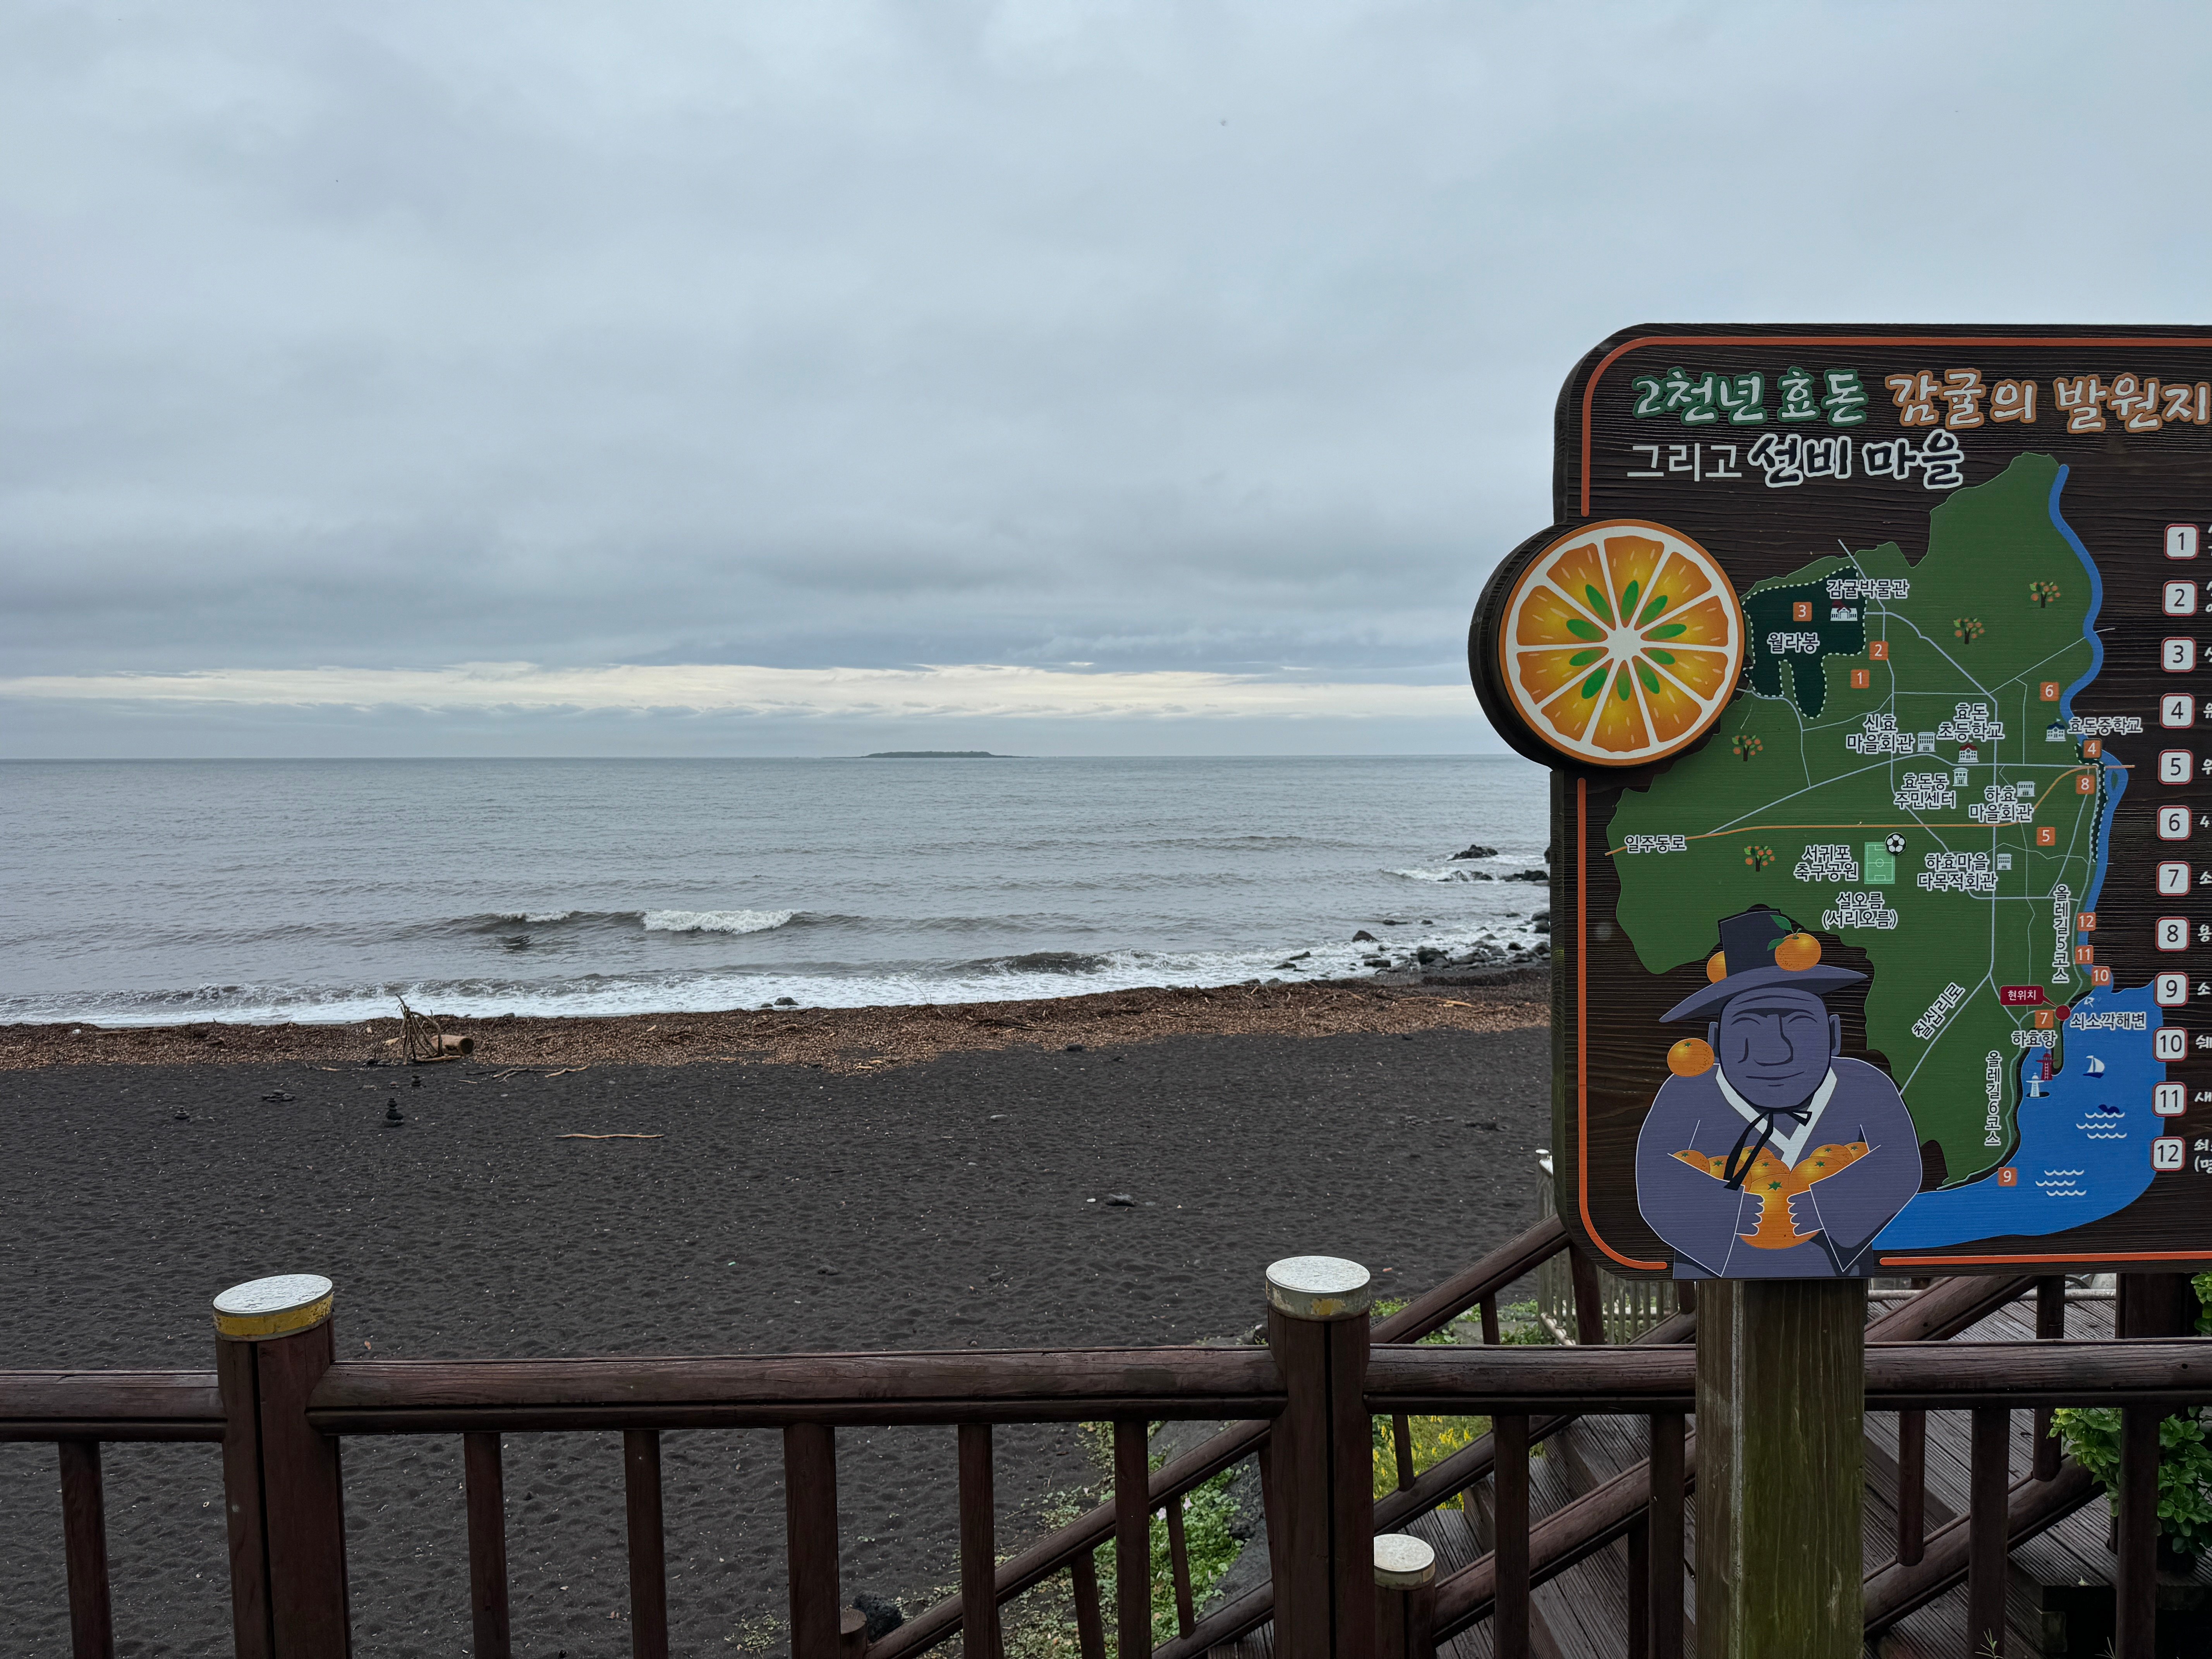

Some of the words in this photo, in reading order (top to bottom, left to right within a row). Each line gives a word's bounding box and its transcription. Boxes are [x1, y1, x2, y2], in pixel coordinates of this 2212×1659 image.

[1632, 366, 1767, 426] 2천년
[1778, 366, 1869, 426] 효돈
[1886, 368, 2037, 429] 감귤의
[2053, 373, 2210, 434] 발원지
[1627, 443, 1741, 482] 그리고
[1862, 429, 1964, 489] 마을
[2178, 532, 2184, 550] 1
[1826, 579, 1910, 599] 감귤박물관
[2174, 589, 2185, 607] 2
[1798, 605, 1806, 618] 3
[1767, 632, 1820, 654] 월라봉
[1874, 644, 1882, 657] 2
[2172, 645, 2183, 663] 3
[1857, 672, 1863, 684] 1
[2045, 685, 2053, 697] 6
[1953, 702, 1989, 722] 효돈
[2171, 701, 2183, 720] 4
[1863, 714, 1898, 733] 신효
[1937, 721, 2005, 742] 초등학교
[2067, 717, 2143, 737] 효돈중학교
[1846, 733, 1915, 754] 마을회관
[2088, 743, 2096, 754] 4
[2171, 758, 2181, 776] 5
[1901, 773, 1949, 791] 효돈동
[2081, 778, 2089, 790] 8
[1893, 790, 1956, 809] 주민센터
[1984, 785, 2017, 804] 하효
[1968, 803, 2034, 824] 마을회관
[2169, 813, 2180, 831] 6
[1624, 835, 1687, 853] 일주동로
[2042, 830, 2050, 842] 5
[1802, 844, 1852, 863] 서귀포
[1925, 852, 1990, 872] 하효마을
[1793, 862, 1859, 882] 축구공원
[2168, 869, 2179, 887] 7
[1917, 871, 1998, 892] 다목적회관
[1836, 891, 1885, 910] 설오름
[1821, 909, 1898, 930] (서리오름)
[2079, 917, 2094, 928] 12
[2167, 924, 2178, 943] 8
[2077, 949, 2090, 960] 11
[2094, 970, 2109, 981] 10
[2008, 990, 2036, 1000] 현위치
[2166, 980, 2177, 998] 9
[1911, 982, 1965, 1041] 칠십리로
[2040, 1012, 2048, 1024] 7
[2070, 1012, 2146, 1030] 쇠소깍해변
[2011, 1030, 2057, 1048] 하효항
[2160, 1035, 2182, 1053] 10
[2160, 1090, 2178, 1108] 11
[2157, 1144, 2179, 1162] 12
[2004, 1170, 2011, 1182] 9
